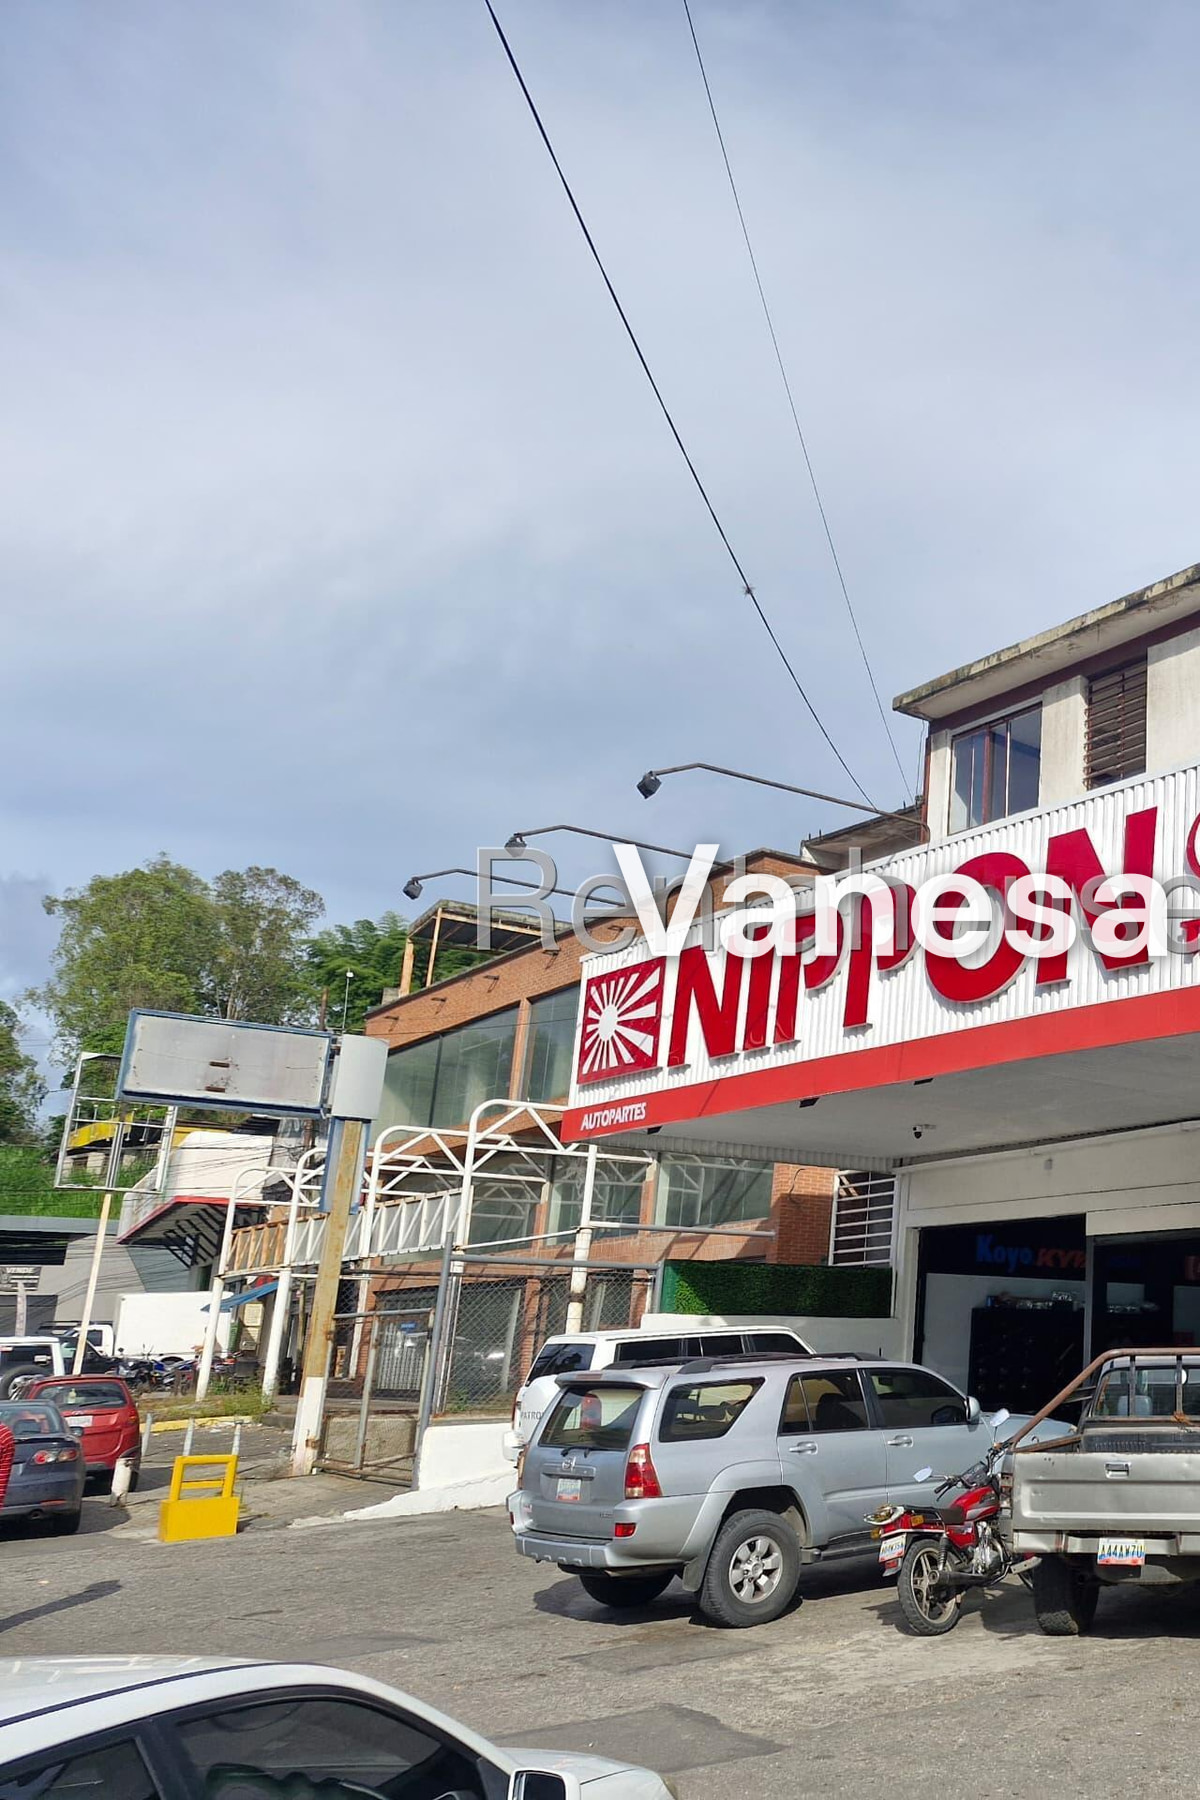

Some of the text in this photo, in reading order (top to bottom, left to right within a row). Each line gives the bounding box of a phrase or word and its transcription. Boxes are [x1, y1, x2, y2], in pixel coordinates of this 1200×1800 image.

[580, 1102, 647, 1131] AUTOPARTES
[976, 1234, 1034, 1273] Koyo
[521, 1411, 544, 1420] PATRO
